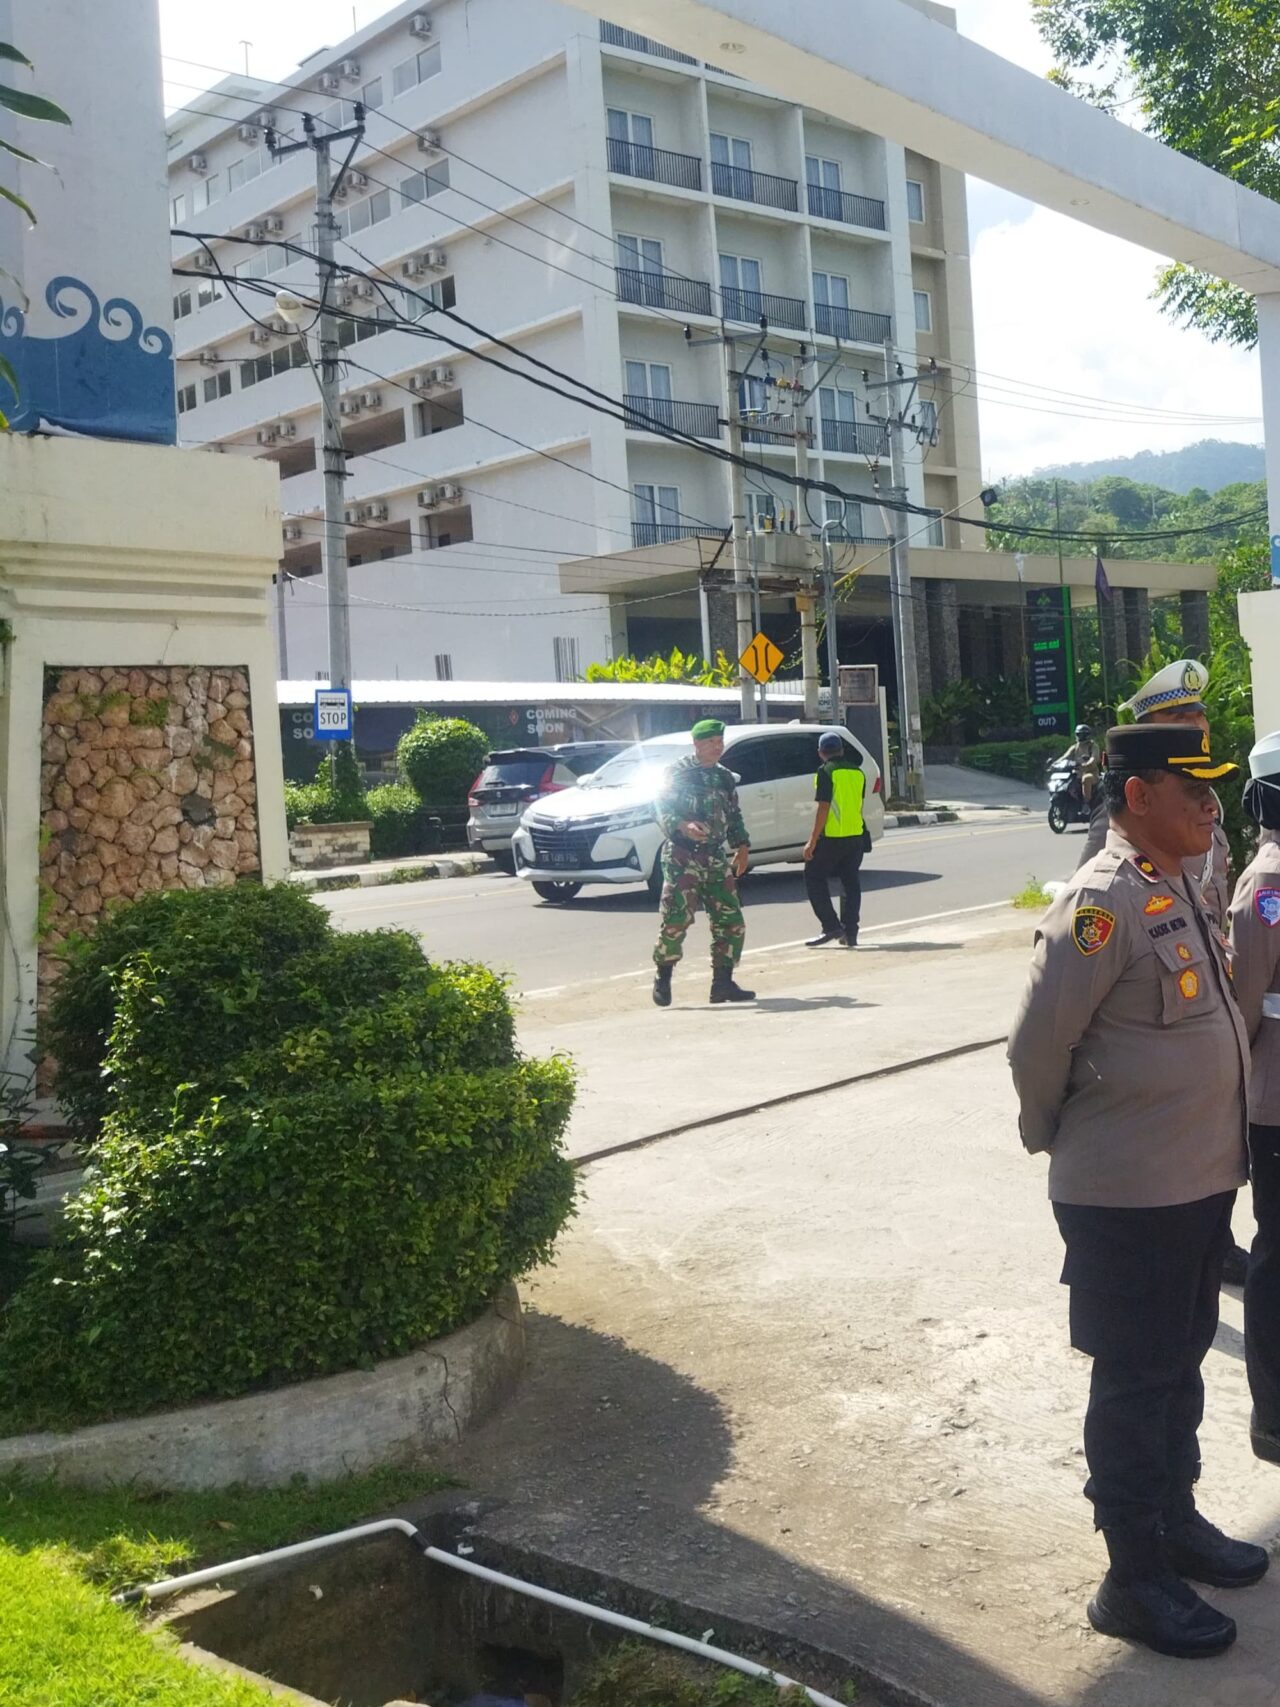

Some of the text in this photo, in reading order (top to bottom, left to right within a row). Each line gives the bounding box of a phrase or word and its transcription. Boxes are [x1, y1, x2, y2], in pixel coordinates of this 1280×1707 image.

[320, 712, 347, 725] STOP
[526, 708, 577, 720] COMING
[292, 727, 315, 740] SO
[527, 722, 564, 735] SOON
